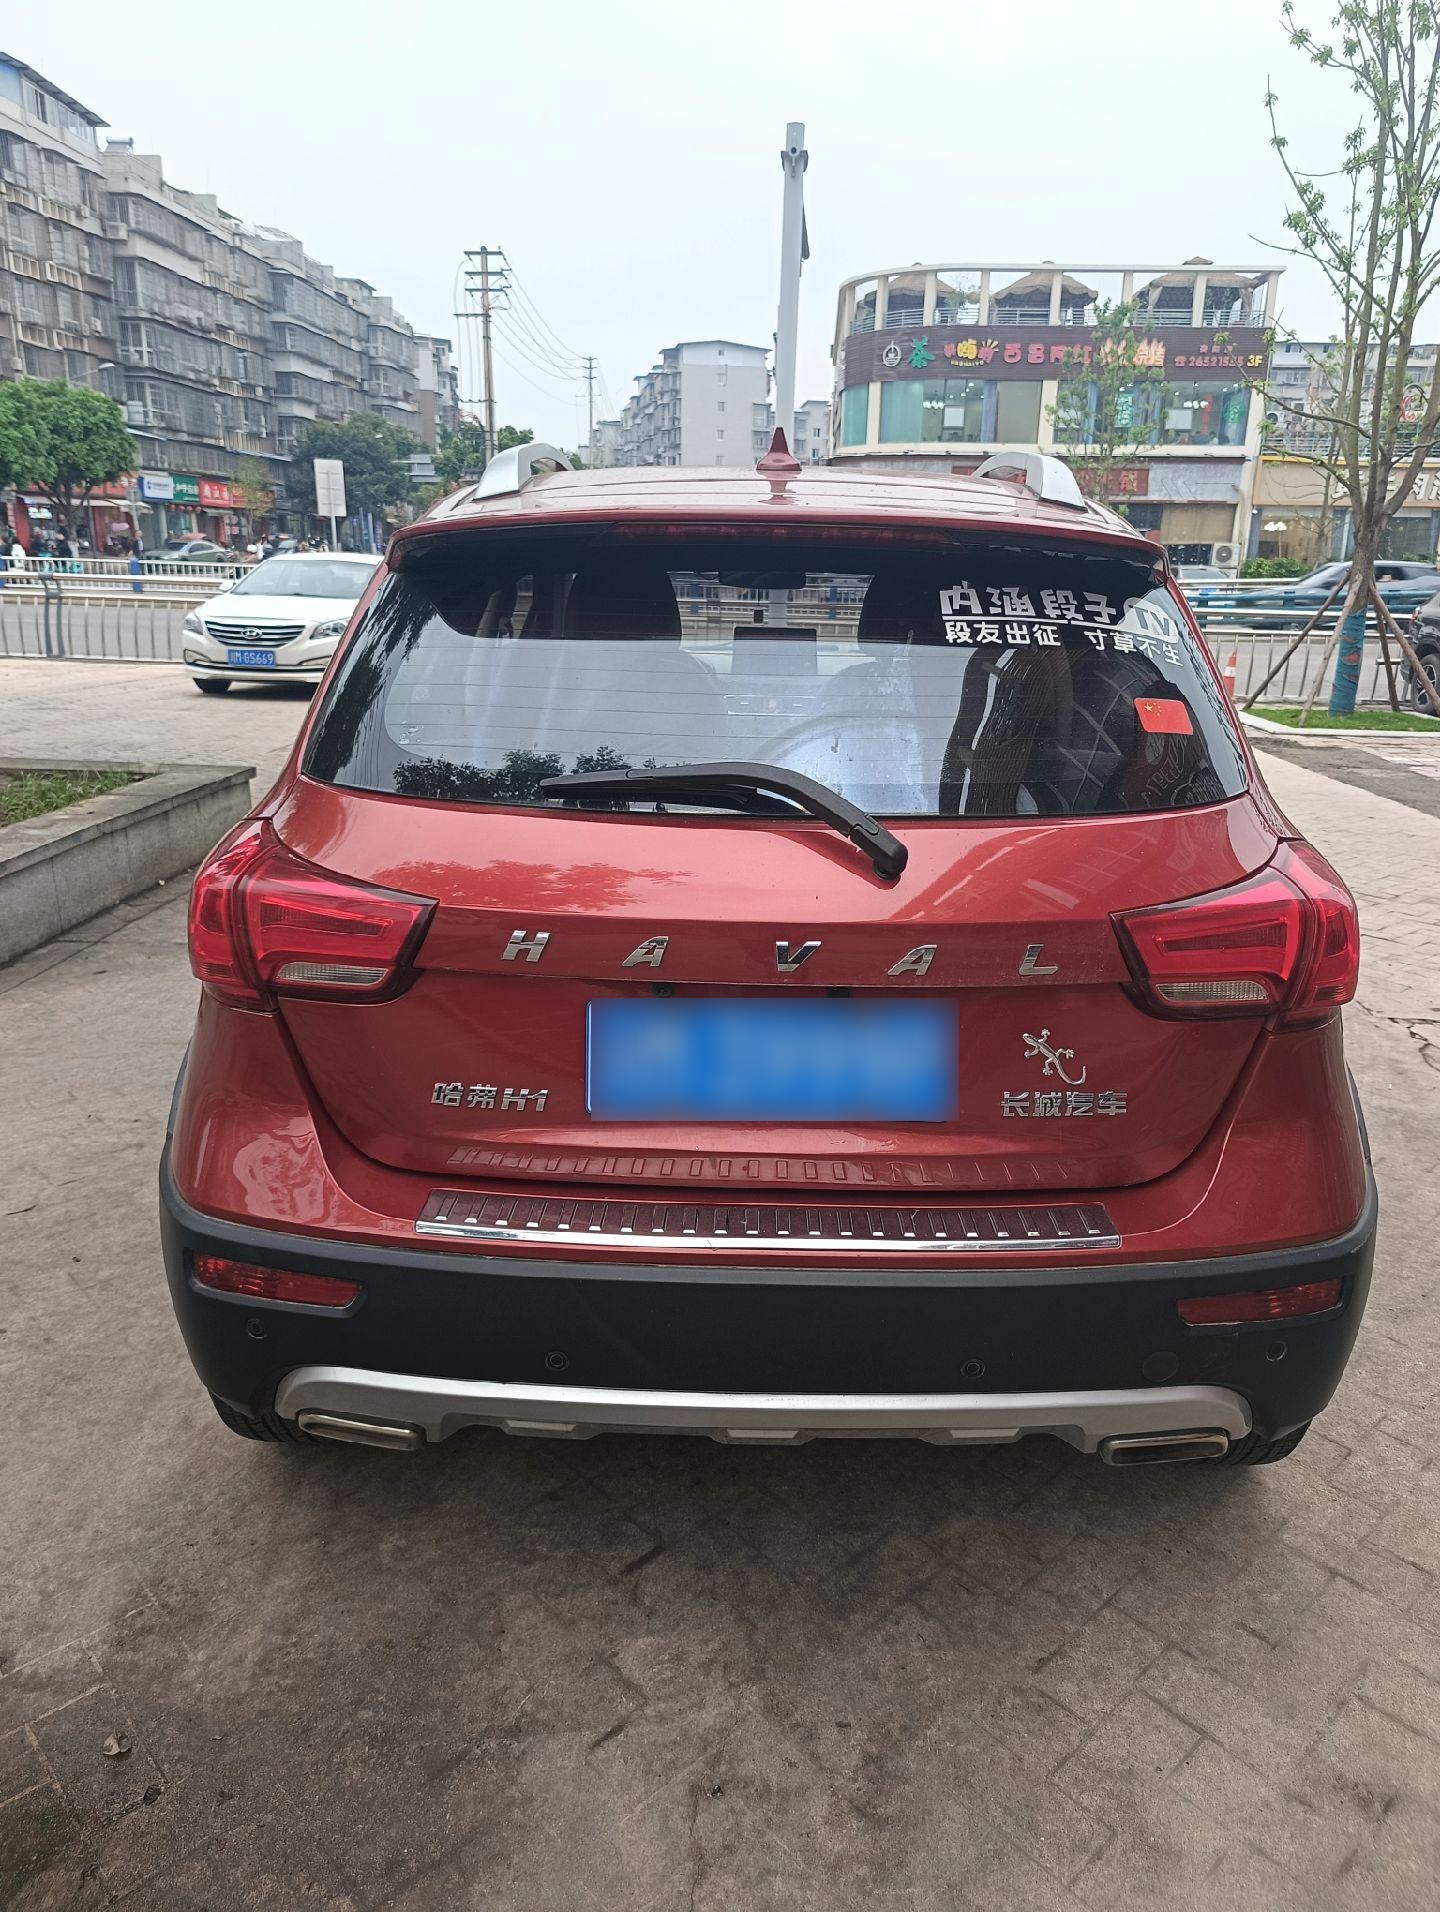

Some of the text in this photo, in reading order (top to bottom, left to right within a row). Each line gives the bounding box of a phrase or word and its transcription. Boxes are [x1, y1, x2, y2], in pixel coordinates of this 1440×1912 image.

[908, 335, 936, 369] 茶
[1247, 354, 1263, 367] 3F
[945, 621, 1184, 667] 段友出征 寸草不生
[502, 929, 1058, 976] HAVAL
[1001, 1090, 1128, 1117] 长城汽车
